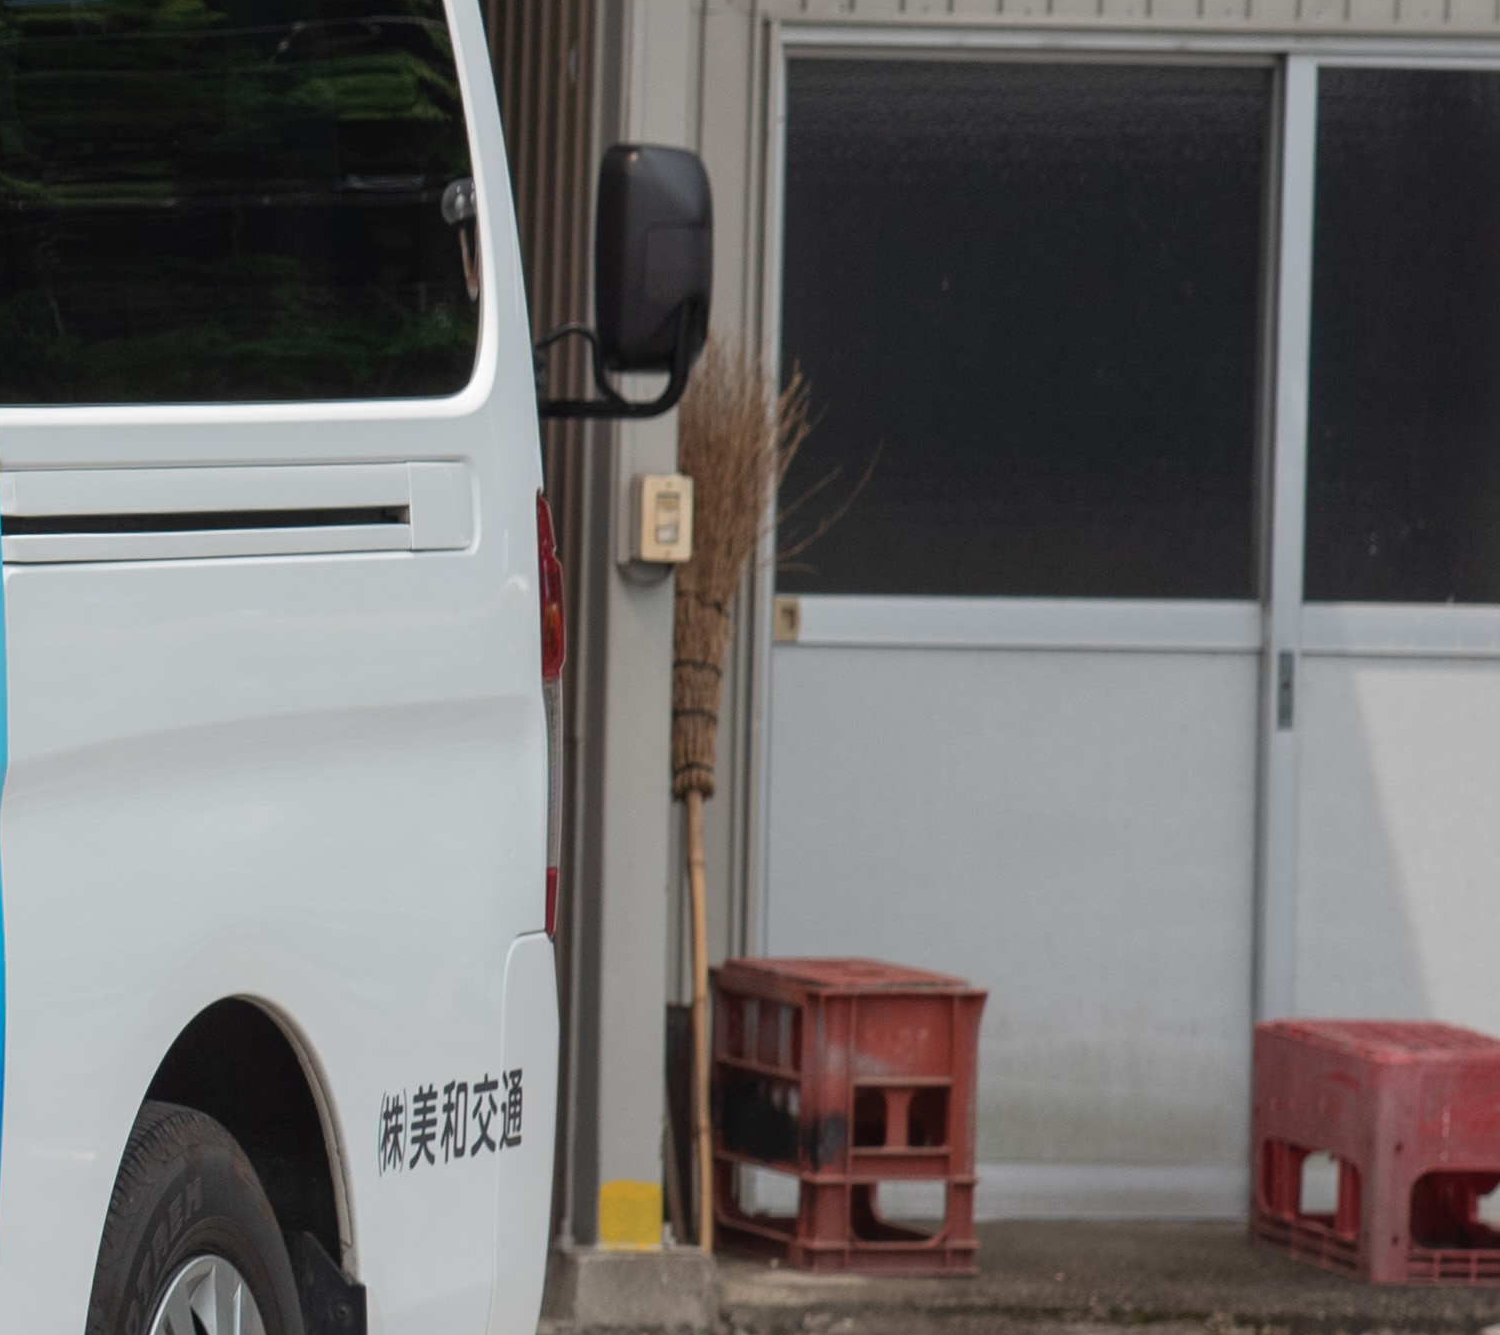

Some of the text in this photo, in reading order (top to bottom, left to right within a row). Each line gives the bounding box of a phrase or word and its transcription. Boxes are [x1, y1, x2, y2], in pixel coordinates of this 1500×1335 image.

[377, 1067, 524, 1178] (株)美和交通
